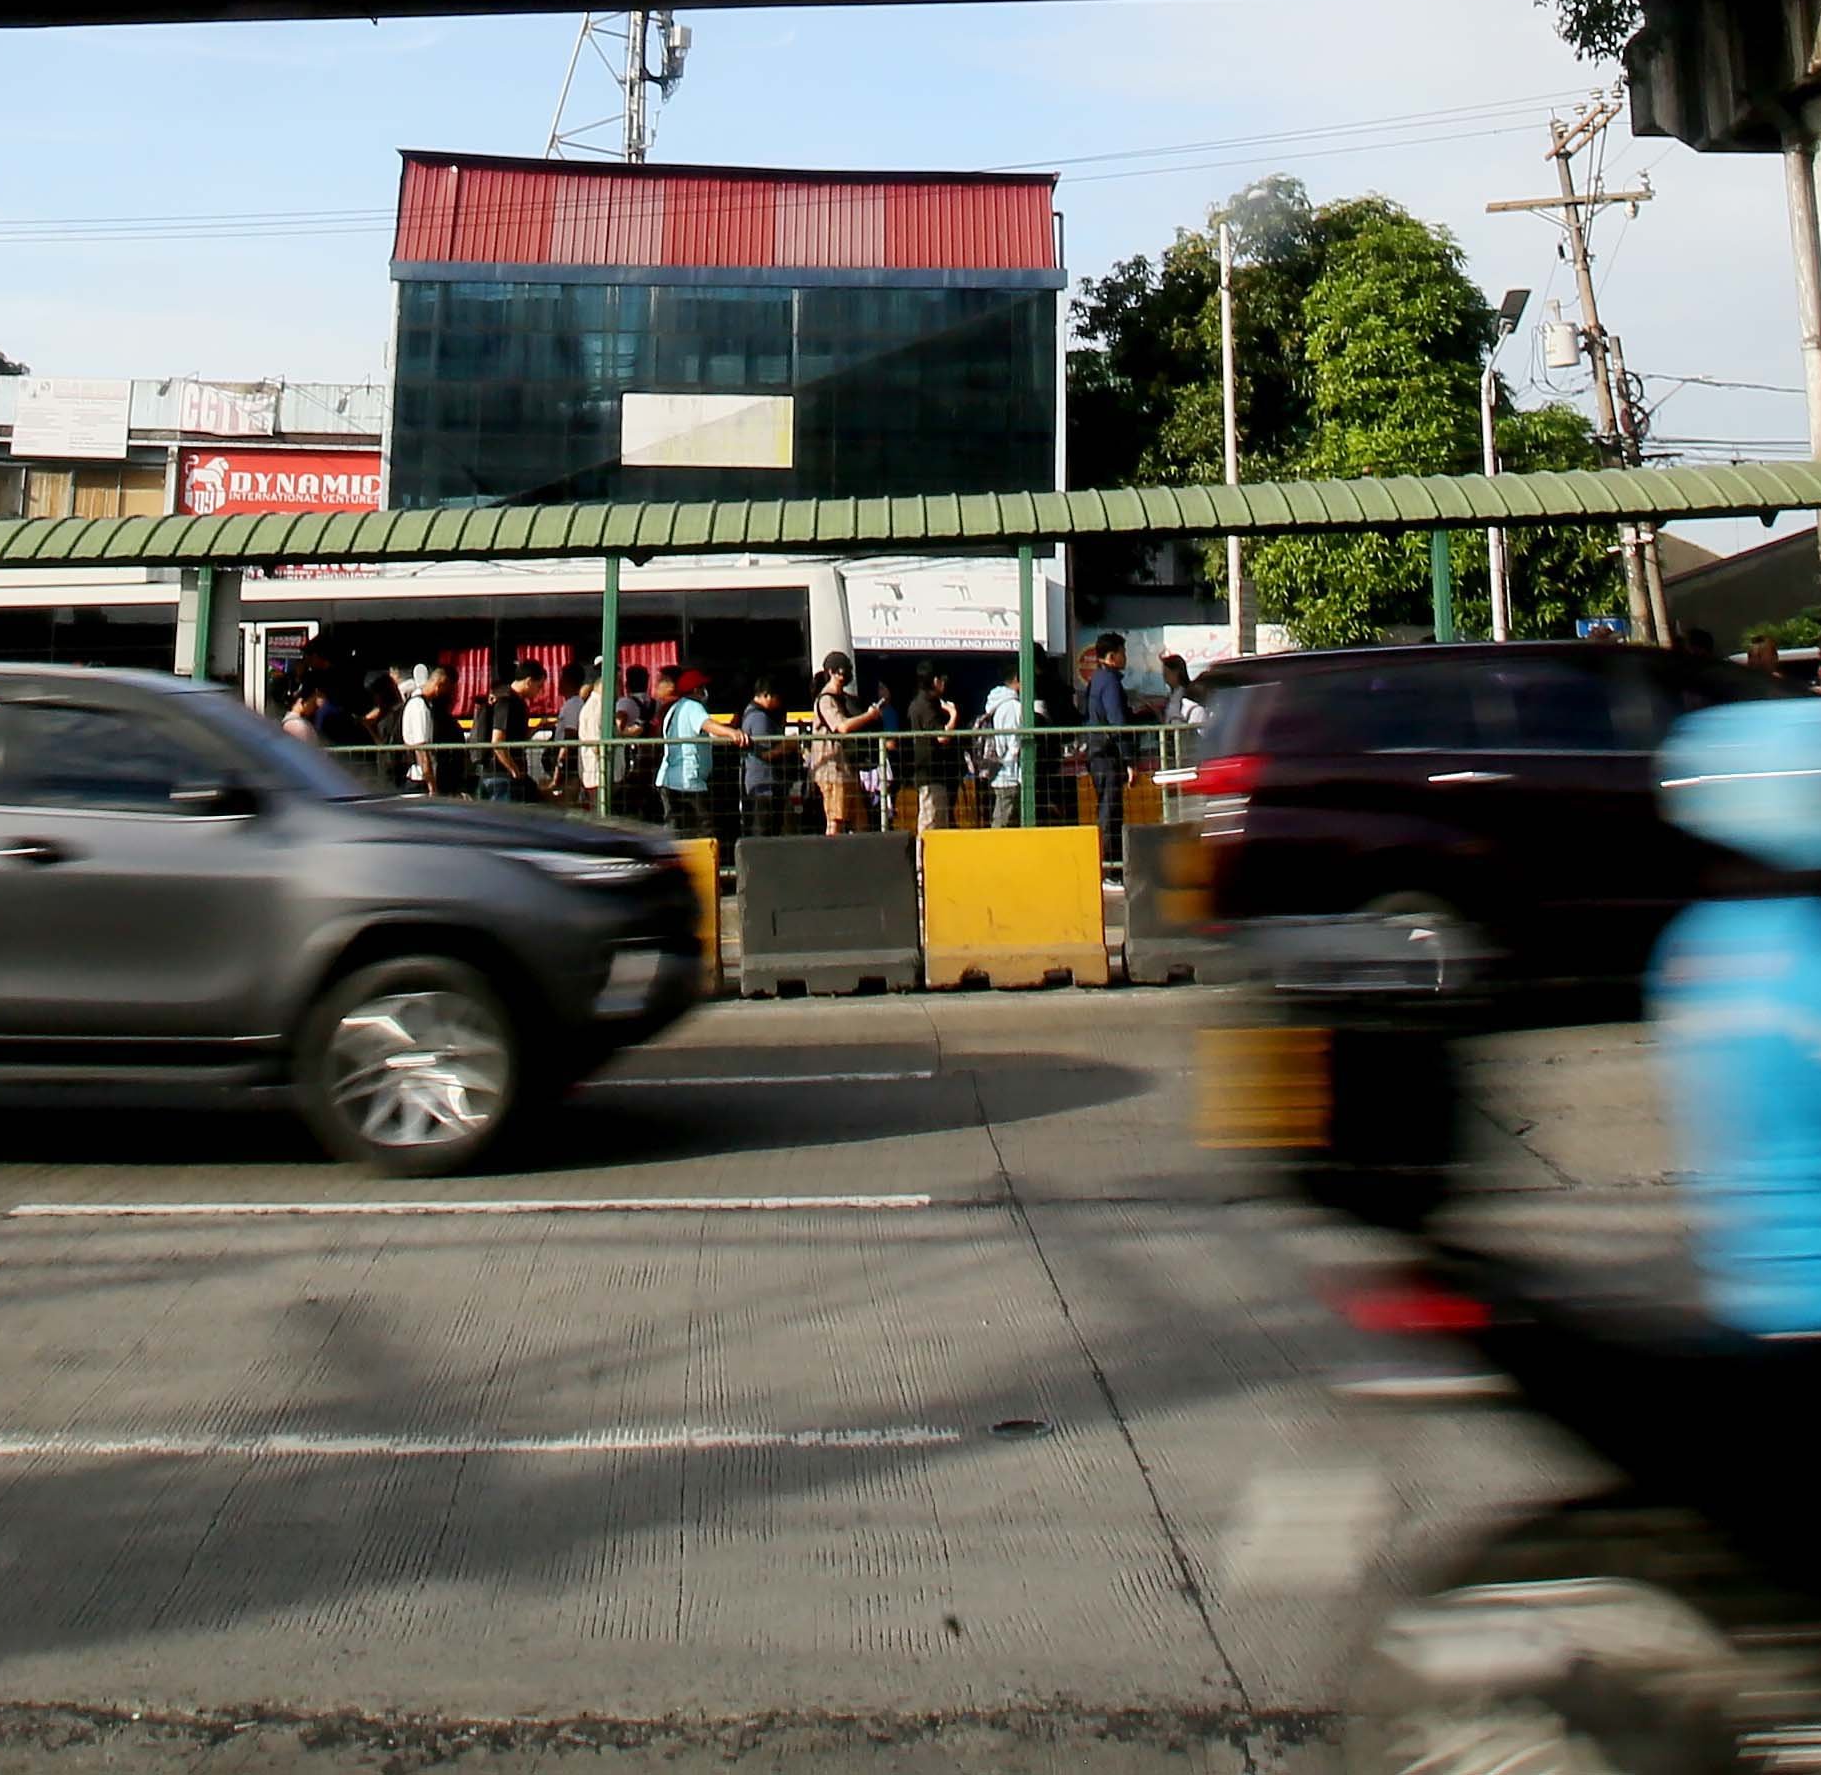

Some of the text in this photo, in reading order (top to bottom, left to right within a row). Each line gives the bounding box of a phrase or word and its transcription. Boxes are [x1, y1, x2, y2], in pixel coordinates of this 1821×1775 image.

[230, 472, 382, 496] DYNAMIC
[229, 490, 318, 504] INTERNATIONAL
[882, 638, 933, 649] SHOOTERS
[934, 639, 960, 649] GUNS
[962, 639, 983, 649] AND
[984, 640, 1011, 650] AMMO
